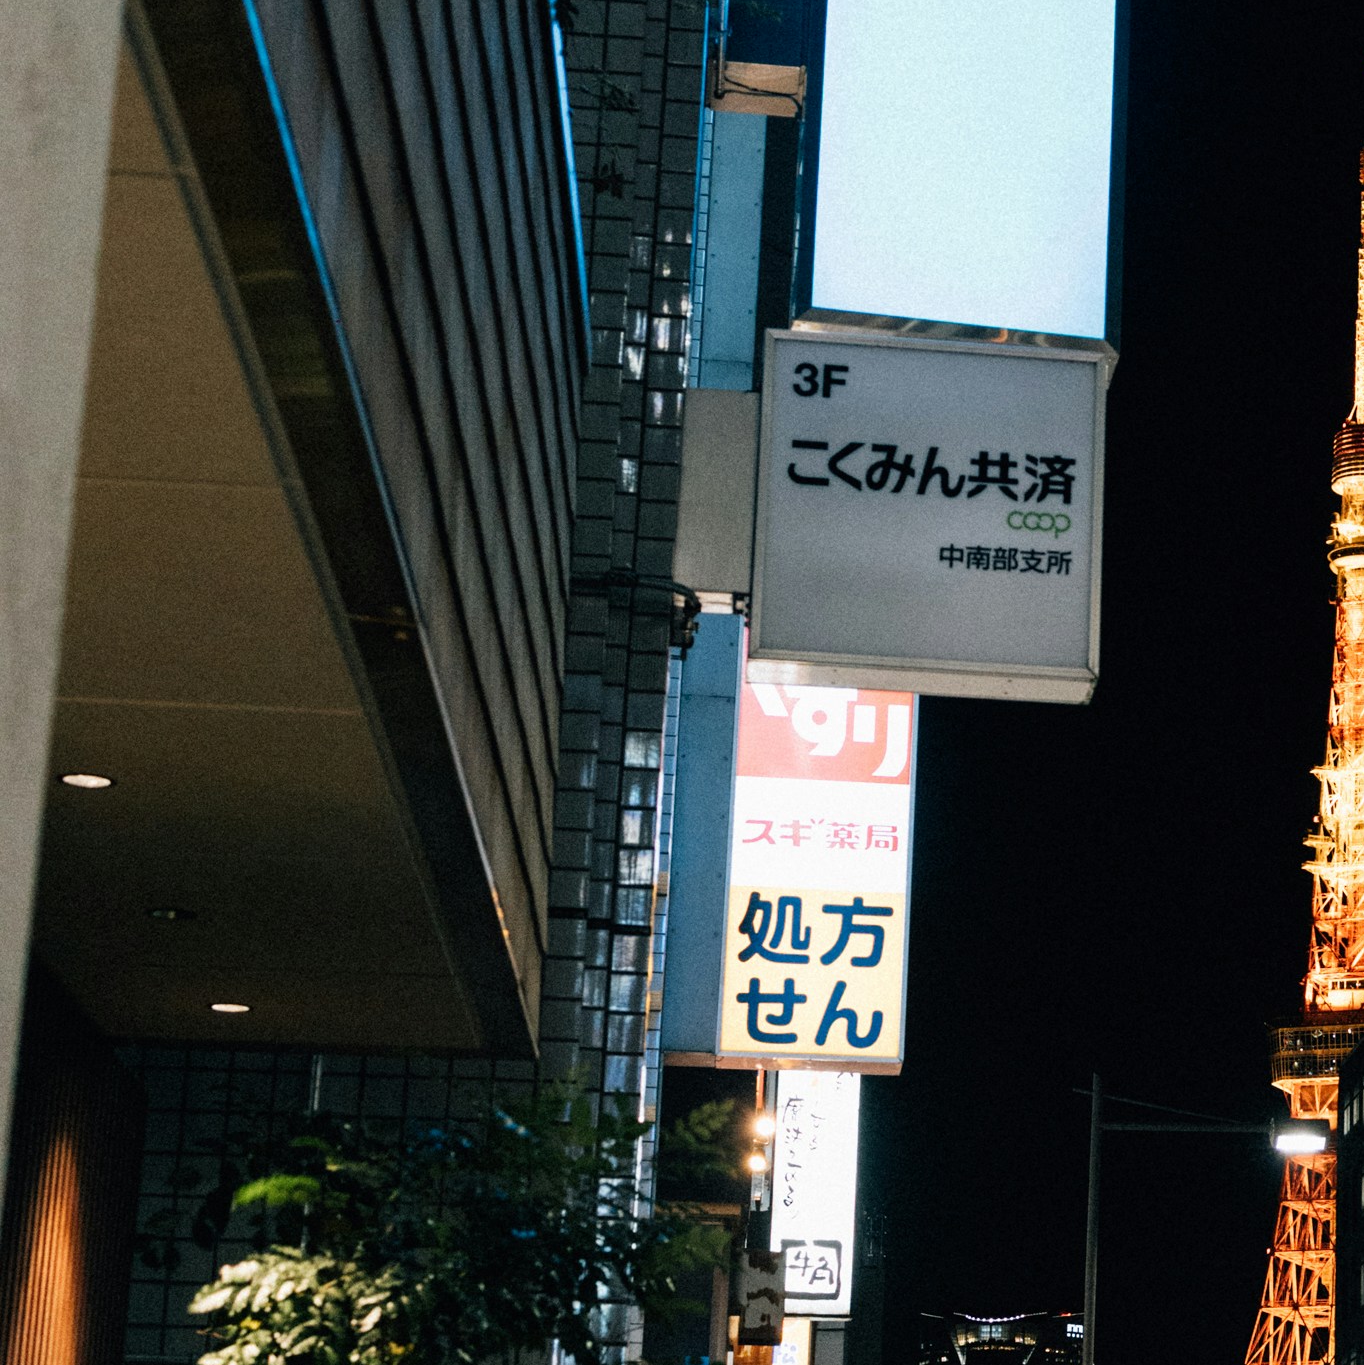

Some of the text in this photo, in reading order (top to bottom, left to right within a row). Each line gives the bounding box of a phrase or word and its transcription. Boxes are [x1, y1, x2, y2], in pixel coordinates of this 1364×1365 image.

[792, 363, 849, 398] 3F
[787, 439, 1077, 504] こくみん共済
[938, 543, 1072, 576] 中南部支所
[742, 817, 899, 852] スギ薬局
[738, 891, 894, 968] 処方
[736, 977, 884, 1049] せん
